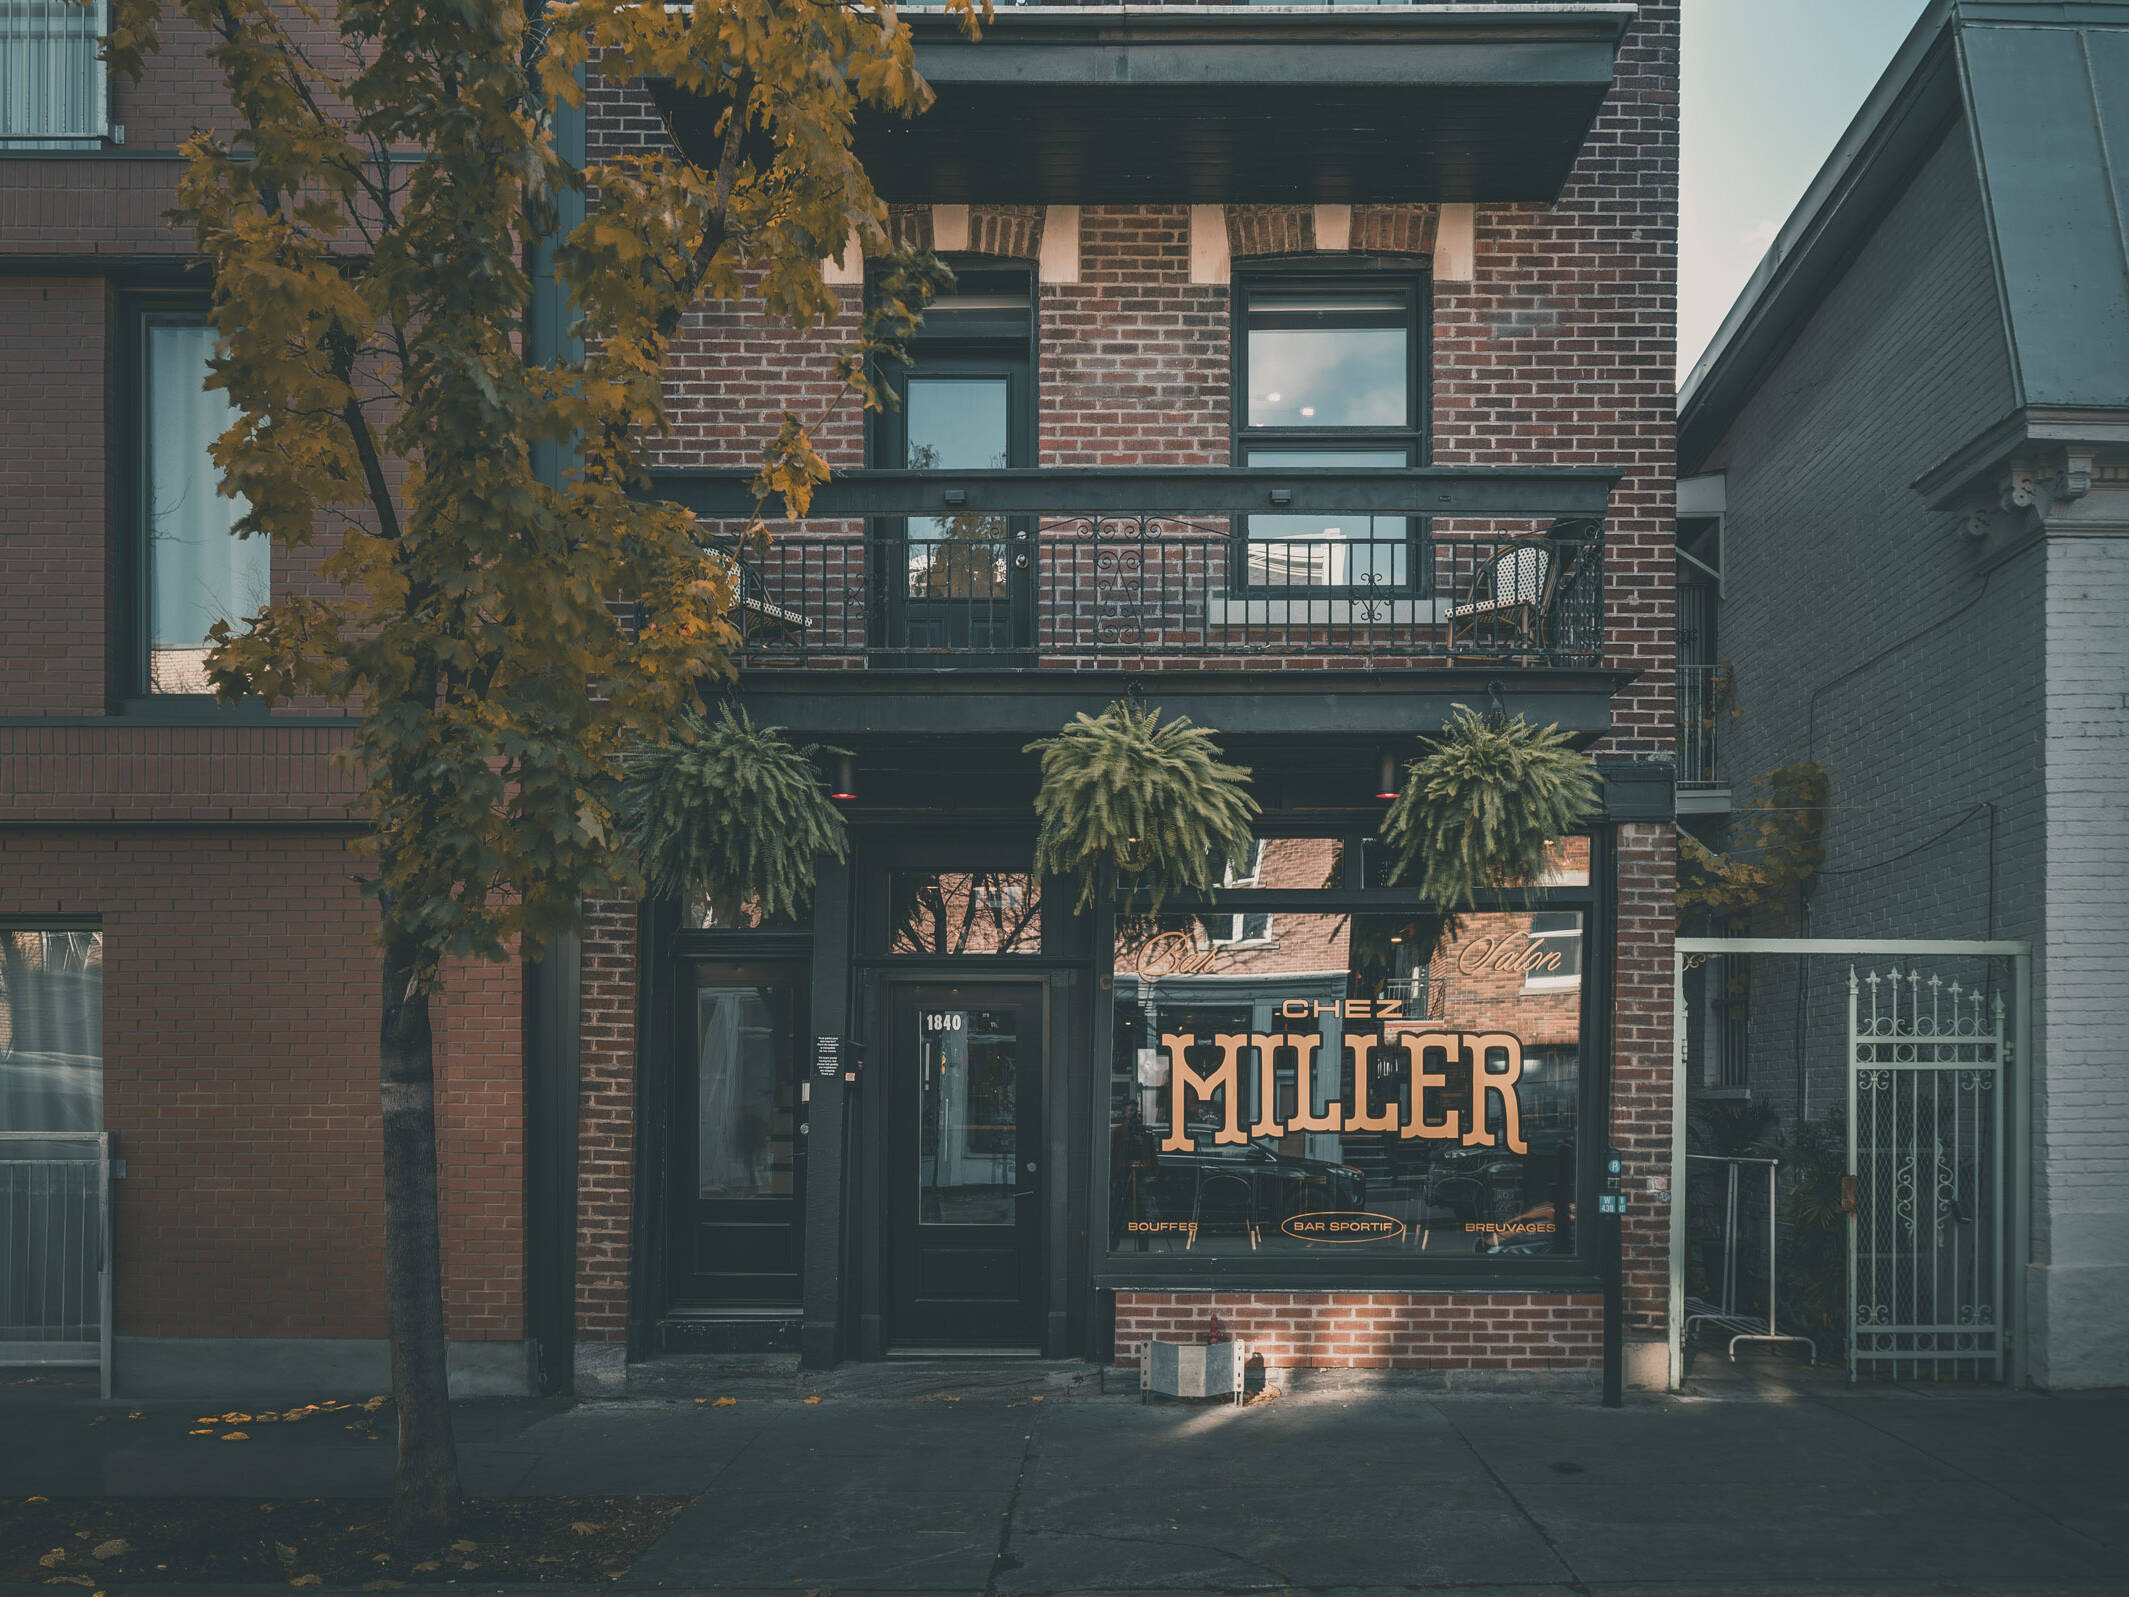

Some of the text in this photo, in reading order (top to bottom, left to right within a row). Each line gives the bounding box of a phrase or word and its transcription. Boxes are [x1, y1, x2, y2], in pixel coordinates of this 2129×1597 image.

[1137, 931, 1218, 983] Bar
[1459, 930, 1562, 975] Salon
[1282, 999, 1403, 1018] CHEZ
[926, 1014, 962, 1031] 1840
[1161, 1033, 1528, 1155] MILLER
[1127, 1222, 1198, 1232] BOUFFES
[1293, 1222, 1393, 1232] BAR SPORTIF
[1465, 1223, 1556, 1233] BREUVAGES
